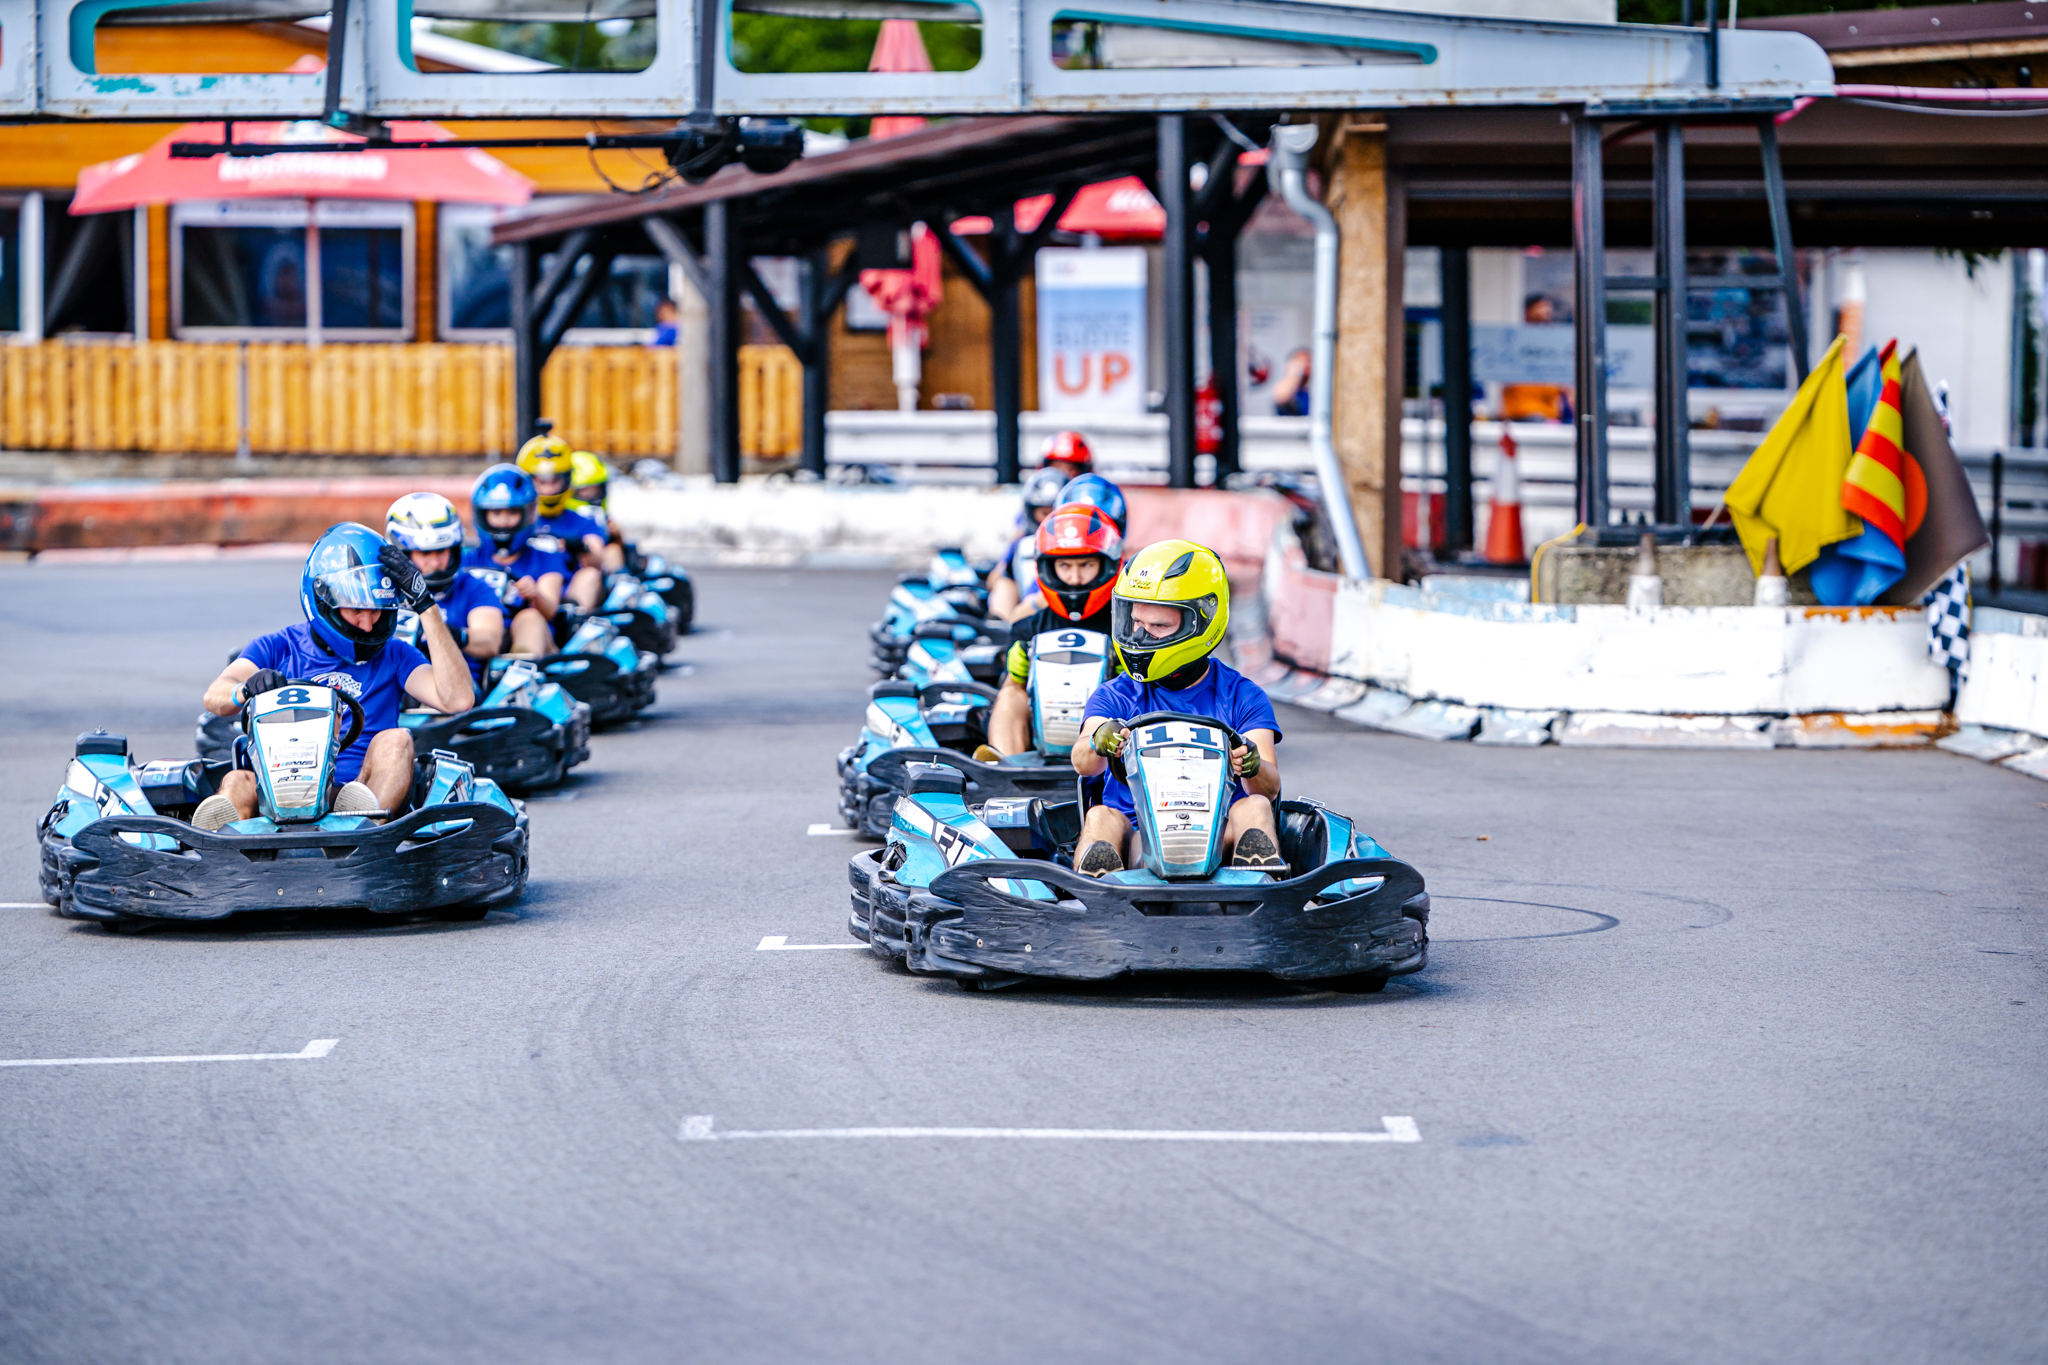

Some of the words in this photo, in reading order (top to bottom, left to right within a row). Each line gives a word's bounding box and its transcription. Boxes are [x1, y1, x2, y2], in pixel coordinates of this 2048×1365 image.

[1053, 352, 1132, 398] UP
[1057, 632, 1087, 648] 9
[276, 688, 311, 705] 8
[1145, 725, 1218, 747] 11
